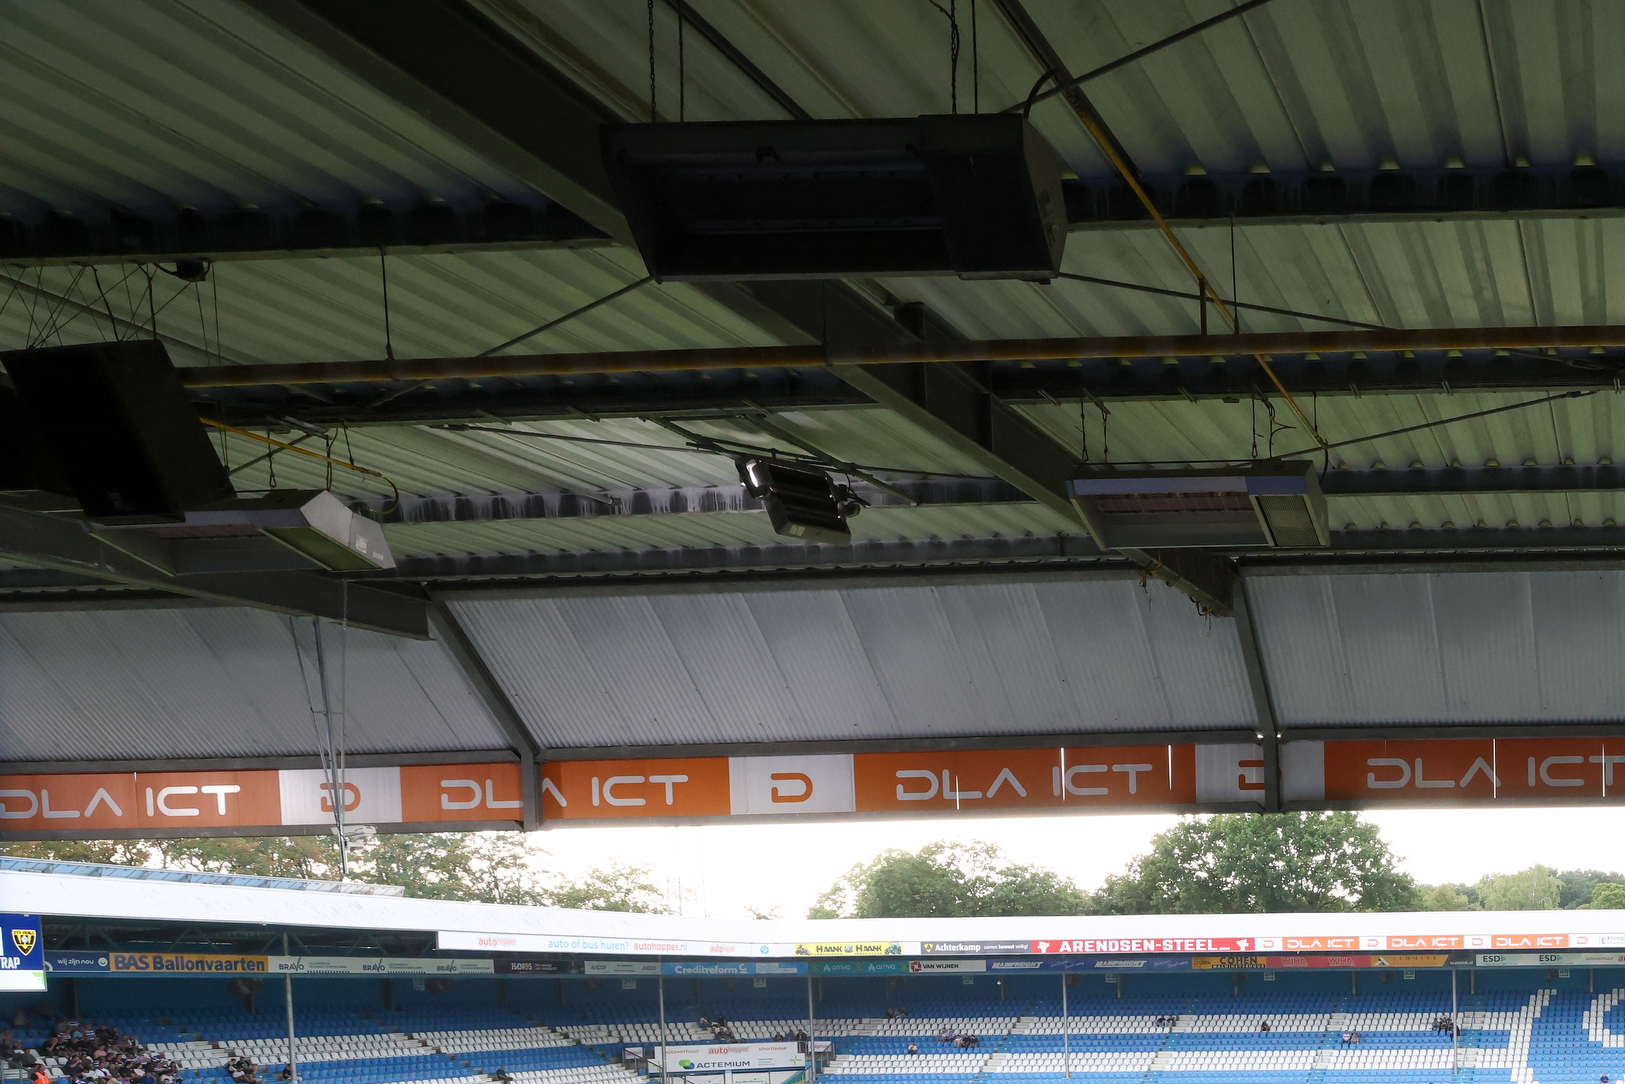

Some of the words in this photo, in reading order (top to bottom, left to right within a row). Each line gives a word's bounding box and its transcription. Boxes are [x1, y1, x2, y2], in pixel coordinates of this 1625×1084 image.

[1366, 757, 1500, 789] DLA
[896, 767, 1027, 800] DLA
[1052, 763, 1153, 796] ICT
[441, 777, 568, 810] DLA
[592, 774, 689, 806] ICT
[770, 772, 813, 803] D
[0, 787, 123, 819] DLA
[146, 784, 240, 817] ICT
[548, 940, 569, 948] auto
[572, 939, 581, 948] of
[583, 940, 598, 949] bus
[601, 941, 629, 951] huren?
[1287, 939, 1322, 948] DLA
[1328, 938, 1354, 948] ICT
[1391, 938, 1426, 947] DLA
[1432, 938, 1458, 947] ICT
[1496, 938, 1531, 946] DLA
[1537, 937, 1563, 946] ICT
[634, 943, 688, 954] autohopper.nl
[935, 943, 981, 953] Achterkamp
[0, 957, 21, 969] RAP
[57, 958, 68, 966] wij
[68, 958, 80, 966] zijn
[1220, 957, 1257, 965] COHEN
[1539, 954, 1557, 962] ESD
[114, 955, 150, 971] BAS
[153, 956, 265, 972] Ballonvaarten
[675, 965, 738, 975] Creditreform
[696, 1060, 750, 1069] ACTEMIUM
